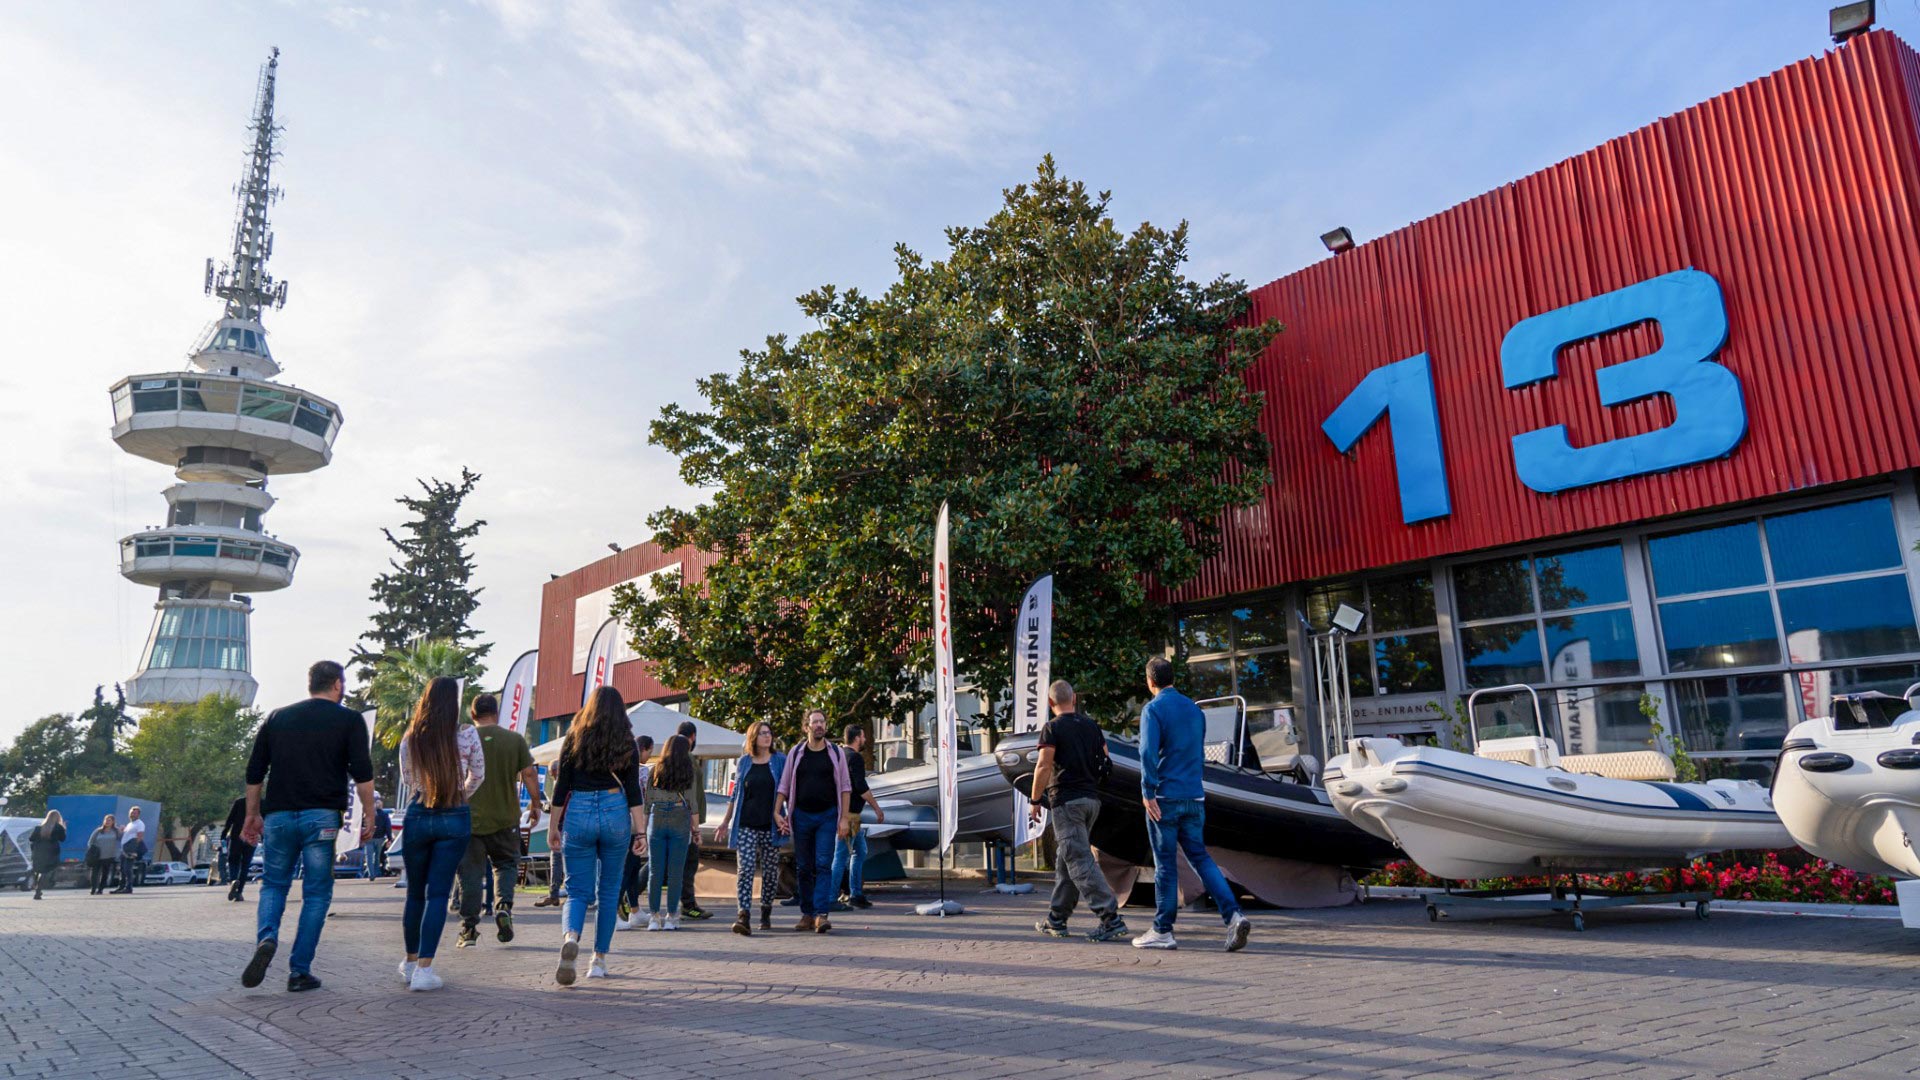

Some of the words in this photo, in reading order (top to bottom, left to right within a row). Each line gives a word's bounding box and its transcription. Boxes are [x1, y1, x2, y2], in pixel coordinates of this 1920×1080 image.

[1321, 267, 1748, 525] 13
[1027, 617, 1039, 718] MARINE
[1378, 704, 1437, 716] ENTRANC
